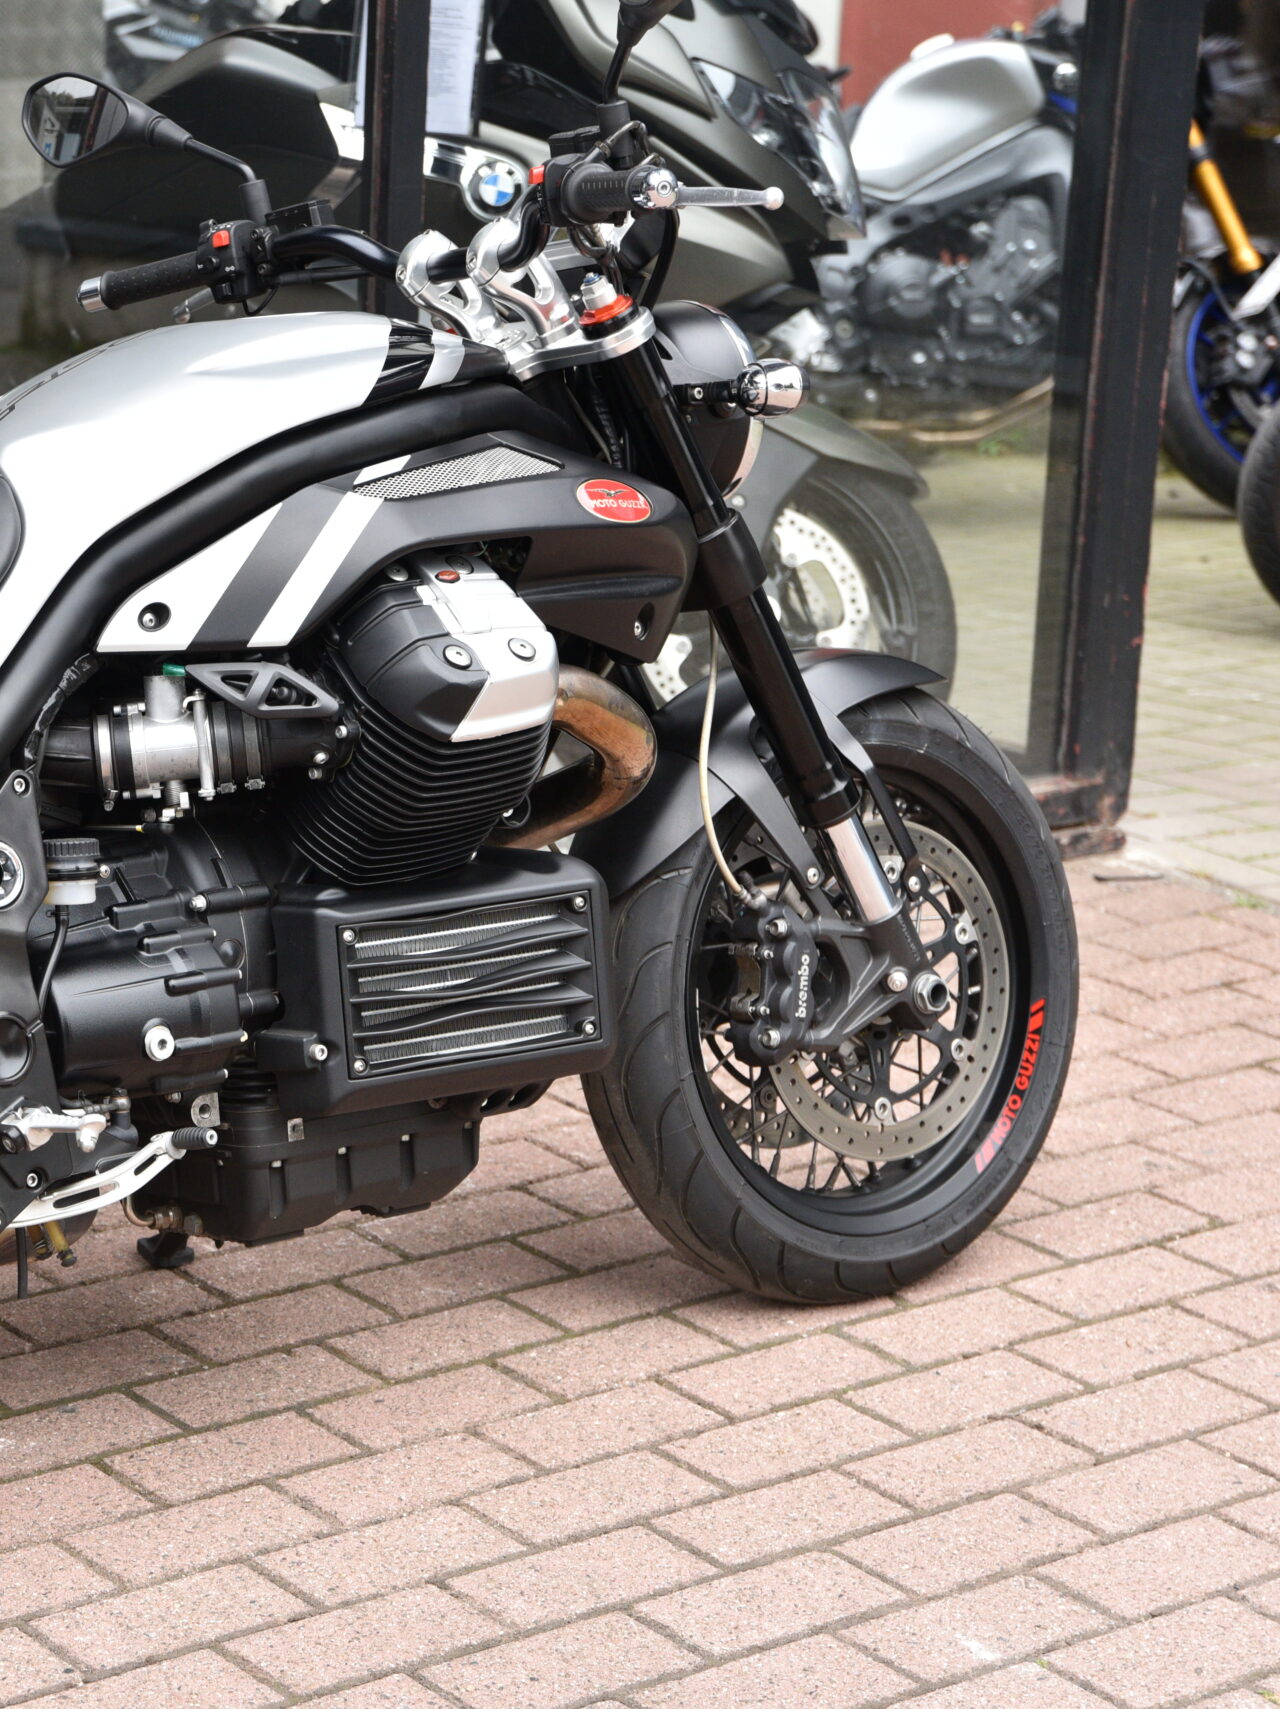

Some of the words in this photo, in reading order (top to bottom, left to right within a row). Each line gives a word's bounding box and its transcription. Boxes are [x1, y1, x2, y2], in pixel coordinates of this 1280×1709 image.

[591, 498, 617, 509] MOTO
[618, 498, 647, 510] GUZZI
[794, 954, 810, 1018] brembo
[991, 1094, 1023, 1145] MOTO
[1015, 1033, 1041, 1091] GUZZI
